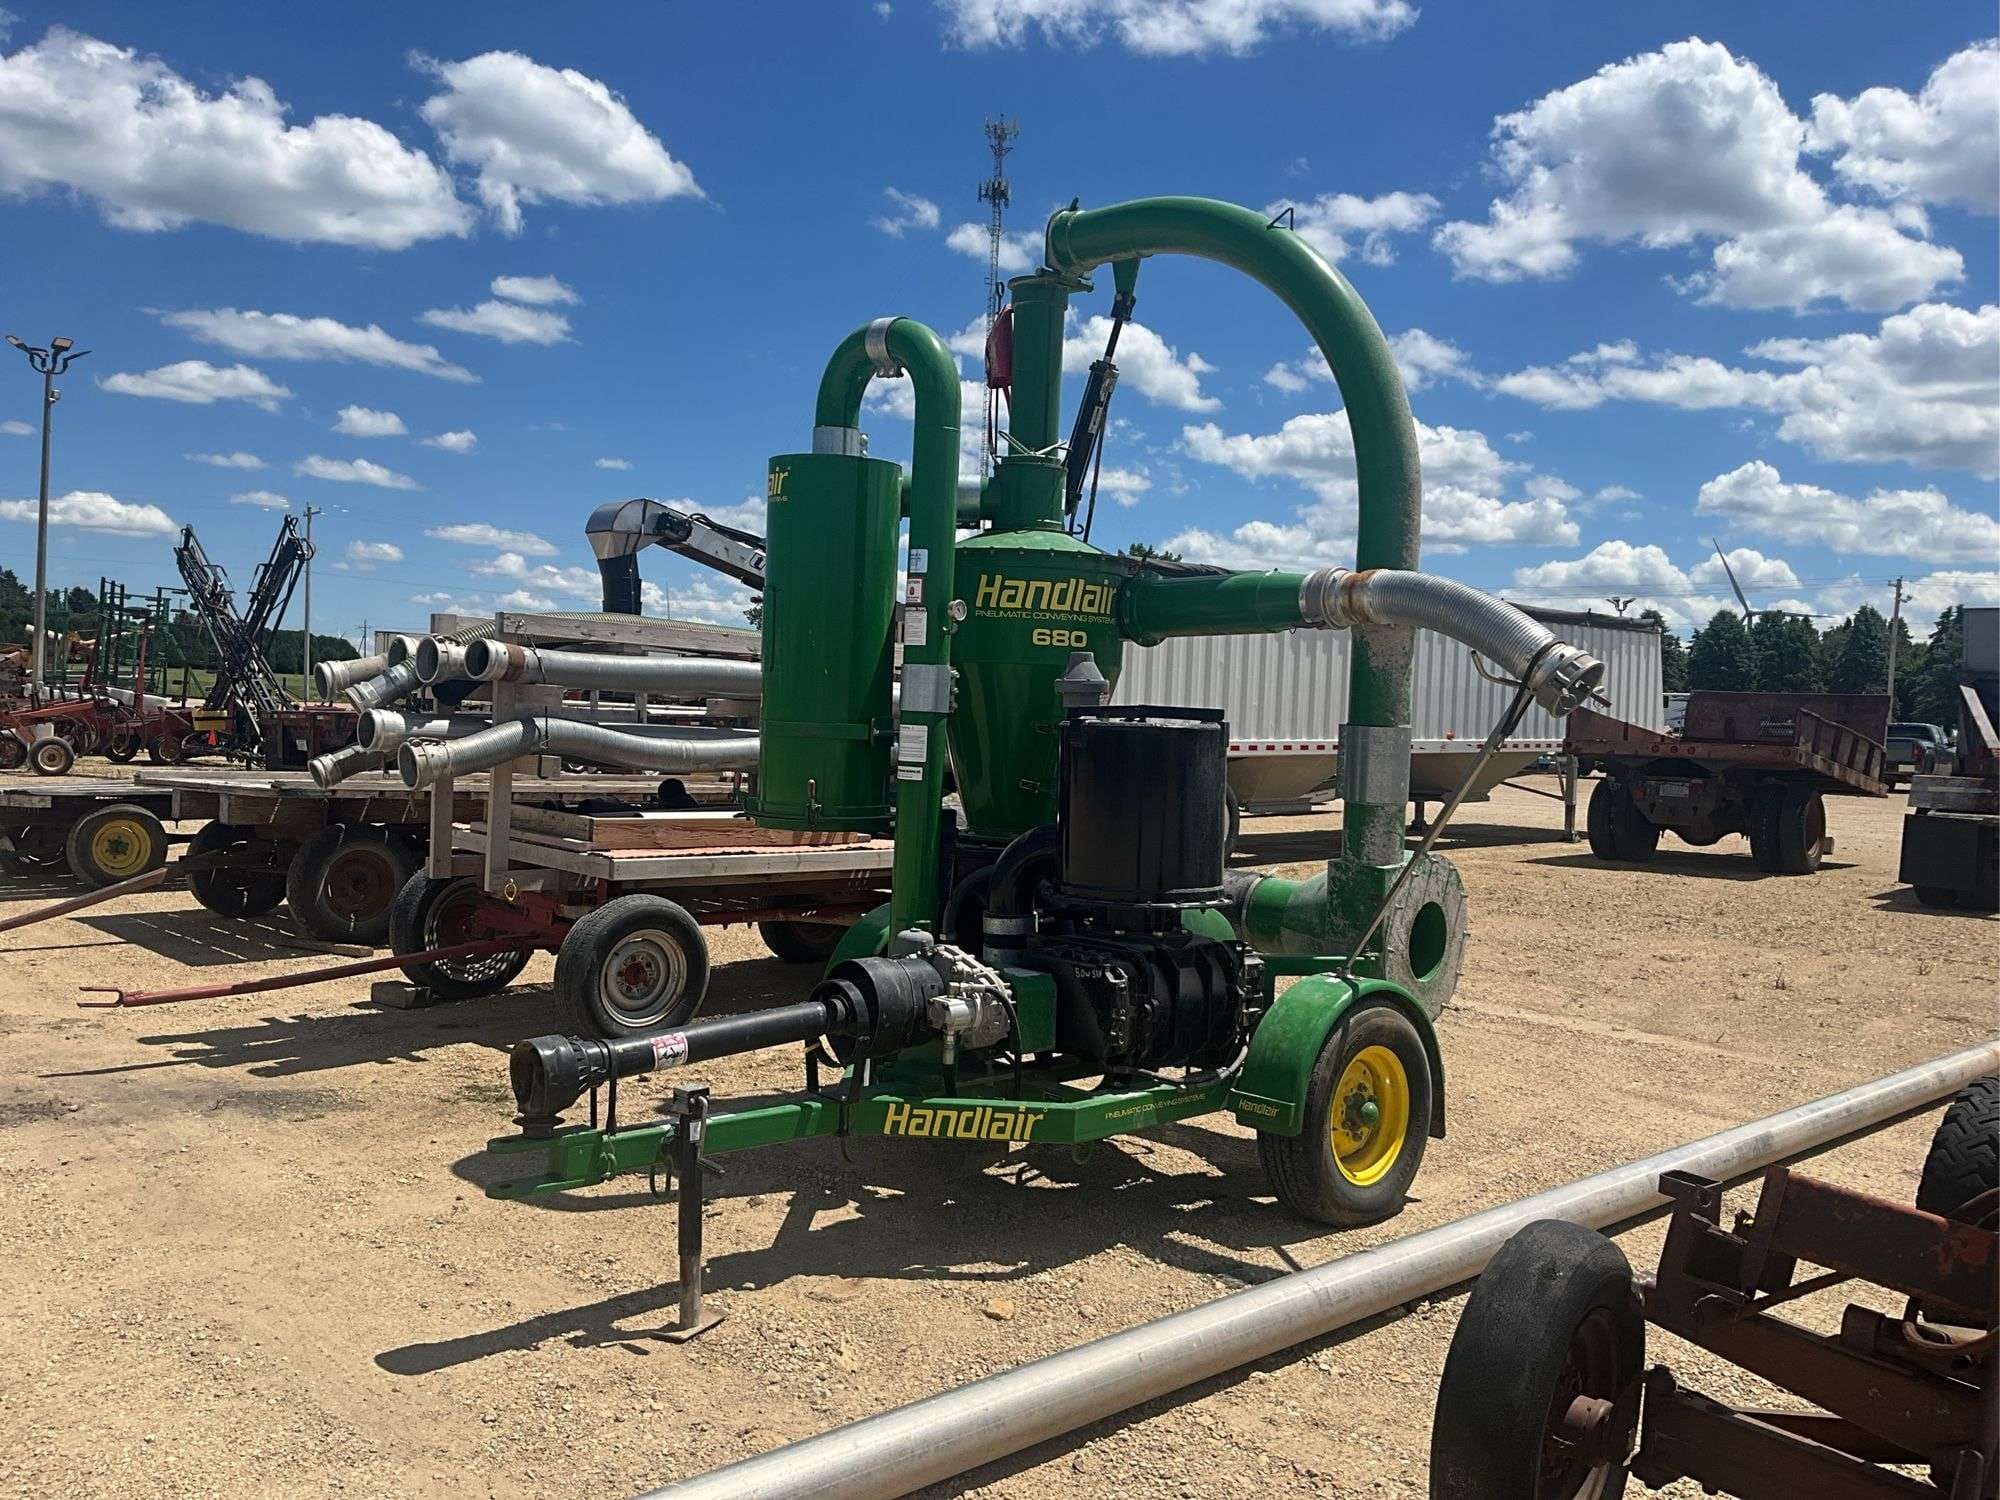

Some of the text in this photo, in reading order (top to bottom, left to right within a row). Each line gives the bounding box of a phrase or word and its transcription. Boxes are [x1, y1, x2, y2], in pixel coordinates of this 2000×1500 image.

[975, 574, 1117, 614] Handlair
[975, 610, 1031, 619] PNEUMATIC
[1032, 611, 1087, 623] CONVEYING
[1032, 628, 1087, 648] 680
[1239, 1098, 1280, 1117] Handlair
[883, 1103, 1044, 1140] Handlair
